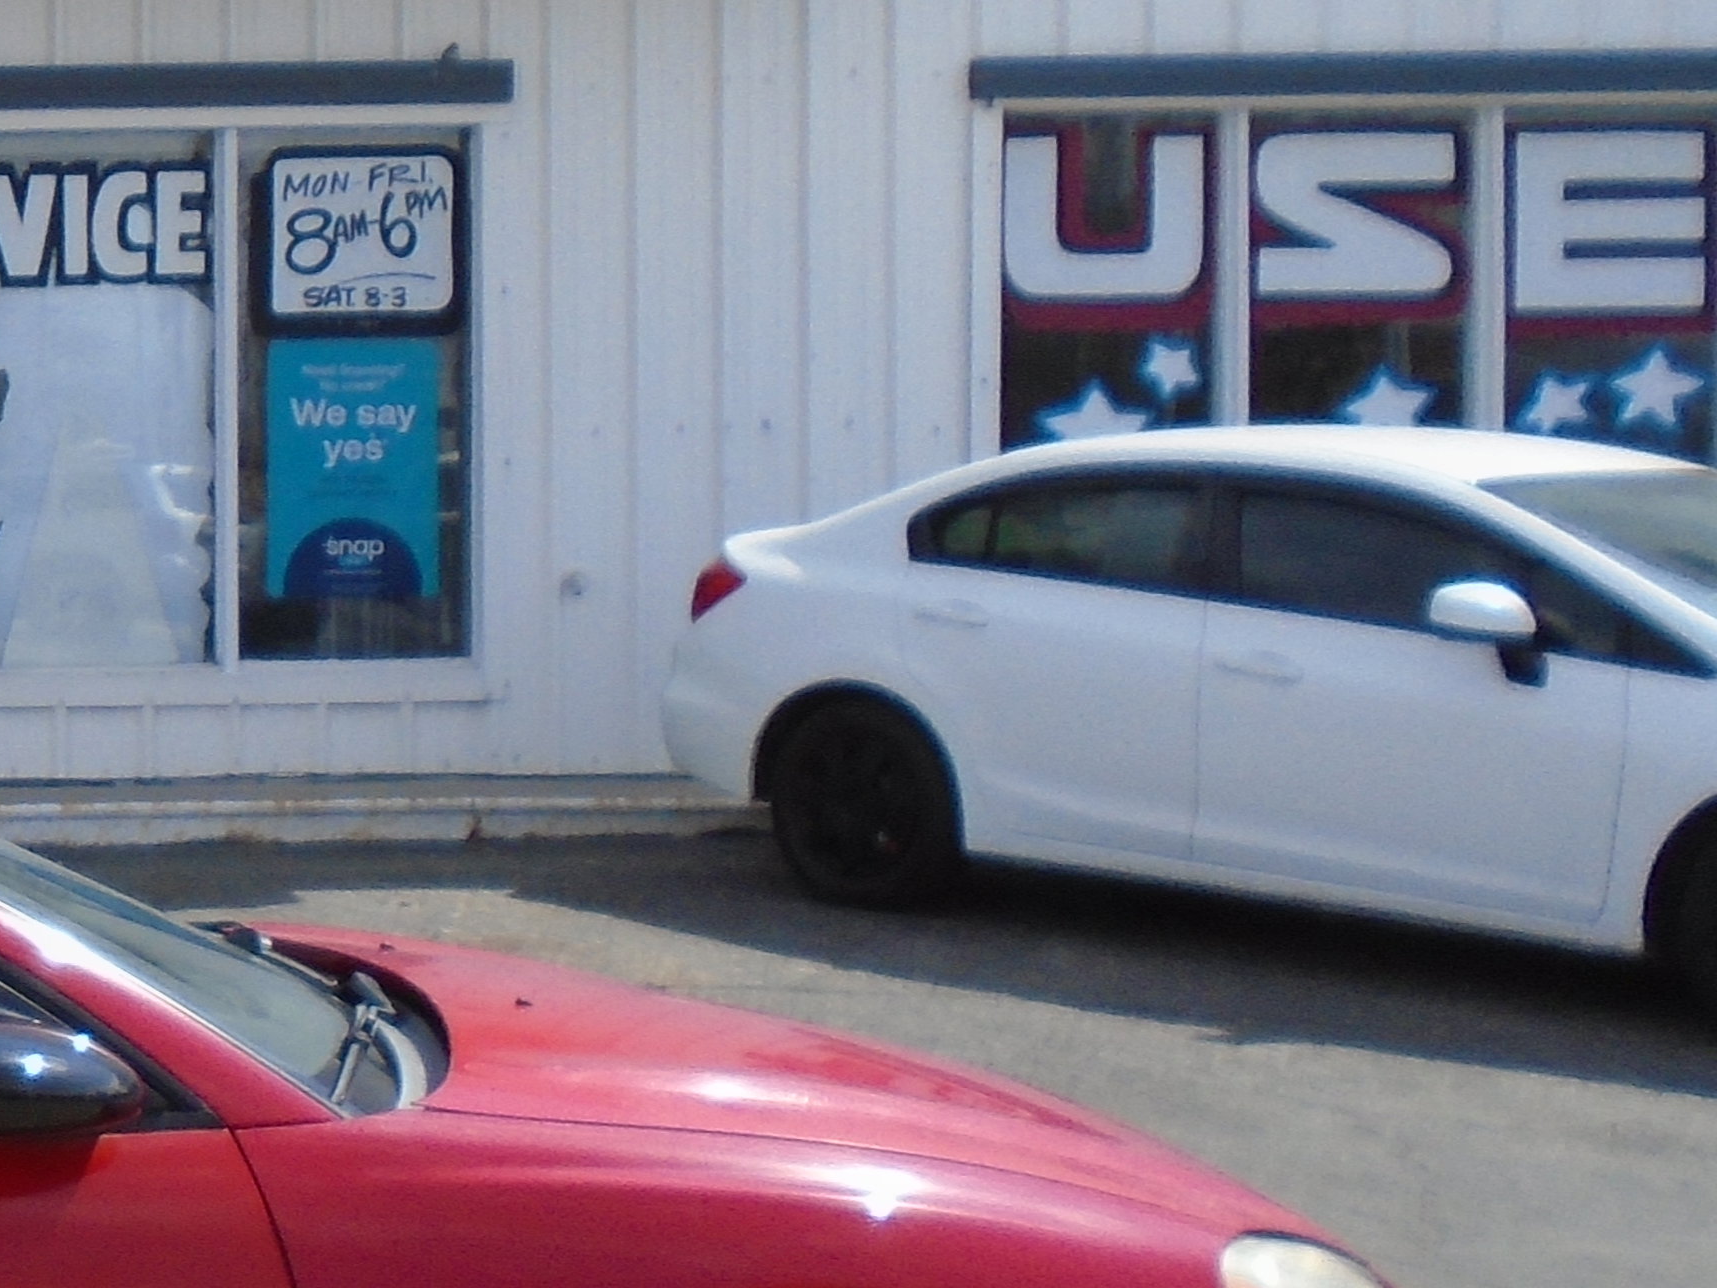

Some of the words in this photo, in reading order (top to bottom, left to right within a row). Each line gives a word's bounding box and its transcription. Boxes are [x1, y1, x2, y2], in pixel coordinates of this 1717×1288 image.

[289, 398, 347, 427] We
[357, 404, 417, 434] say
[323, 438, 385, 469] yes
[325, 537, 385, 562] snap
